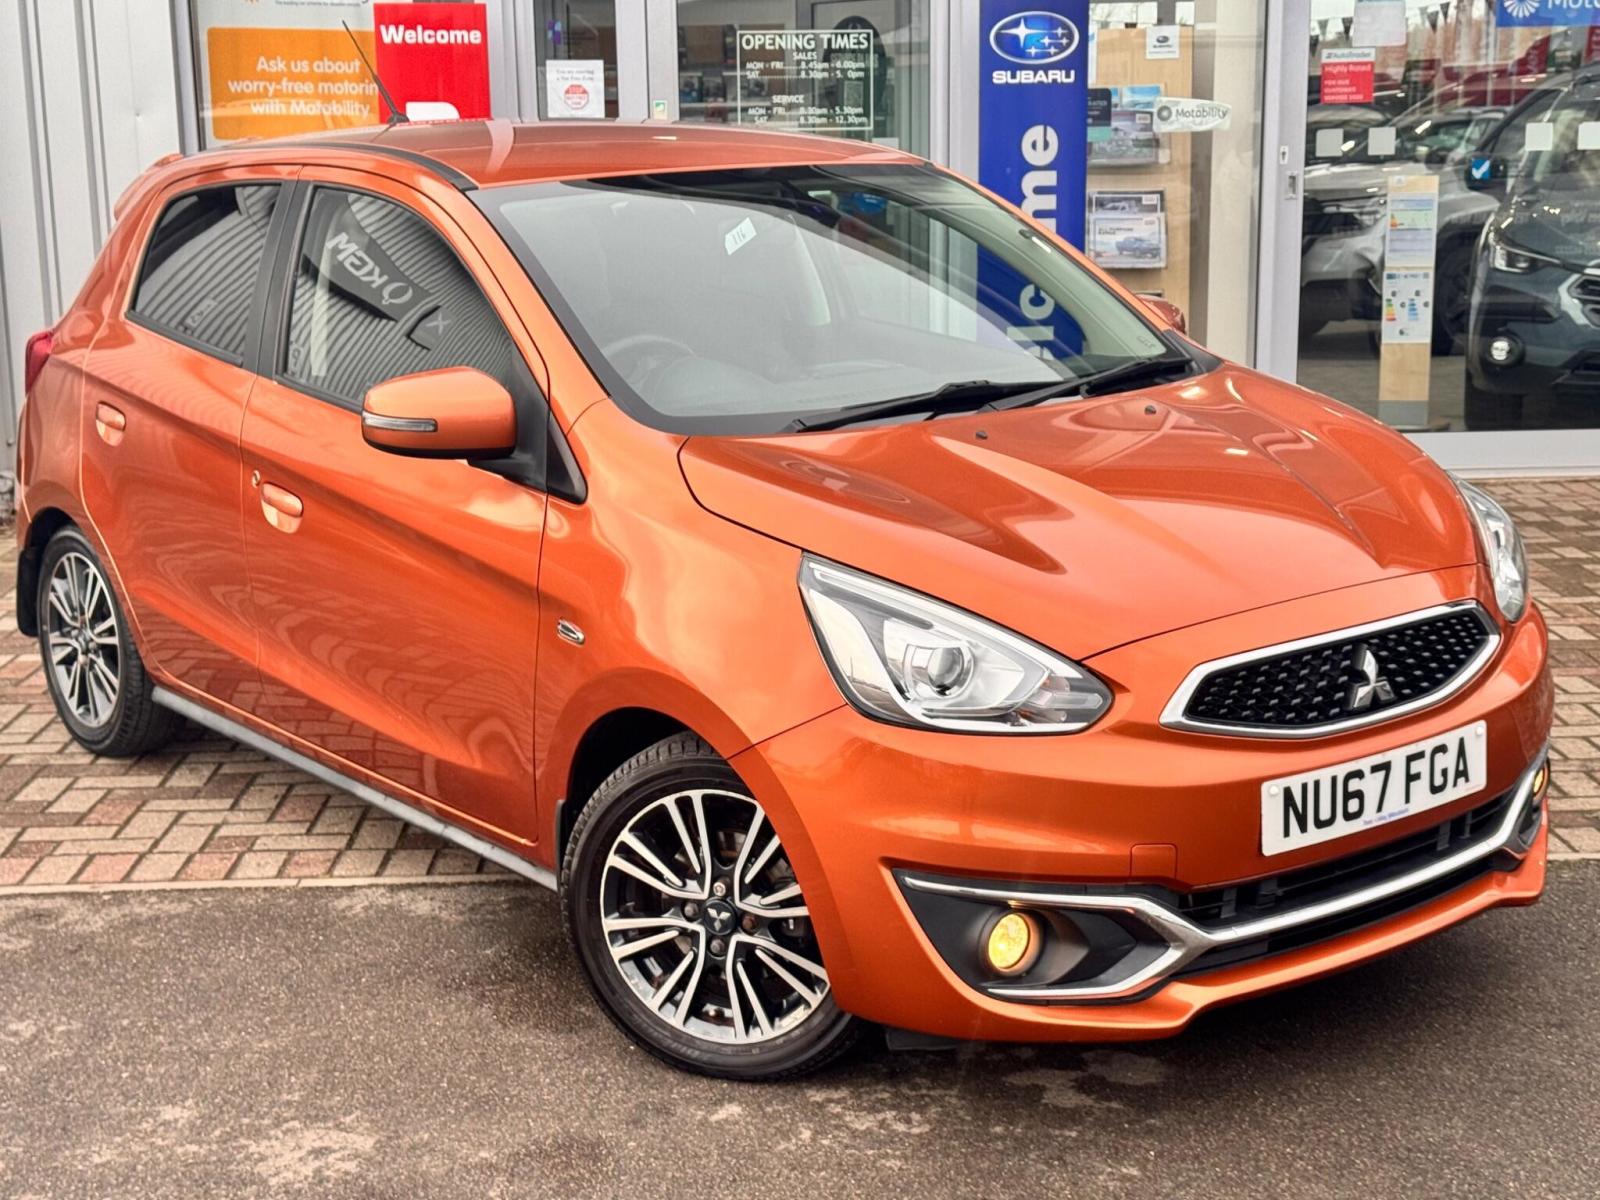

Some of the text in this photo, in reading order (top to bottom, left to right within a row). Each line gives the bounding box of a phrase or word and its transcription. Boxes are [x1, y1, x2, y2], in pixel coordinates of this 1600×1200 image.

[380, 25, 482, 44] Welcome
[741, 33, 868, 50] OPENING TIMES
[793, 52, 817, 60] SALES
[256, 56, 361, 73] Ask us about
[746, 62, 764, 70] MON
[746, 70, 760, 79] SAT
[992, 70, 1075, 84] SUBARU
[228, 77, 379, 97] worry-free motorin
[772, 94, 804, 104] SERVICE
[251, 99, 370, 120] with Motability
[1175, 107, 1229, 119] Motability
[1283, 736, 1471, 839] NU67 FGA
